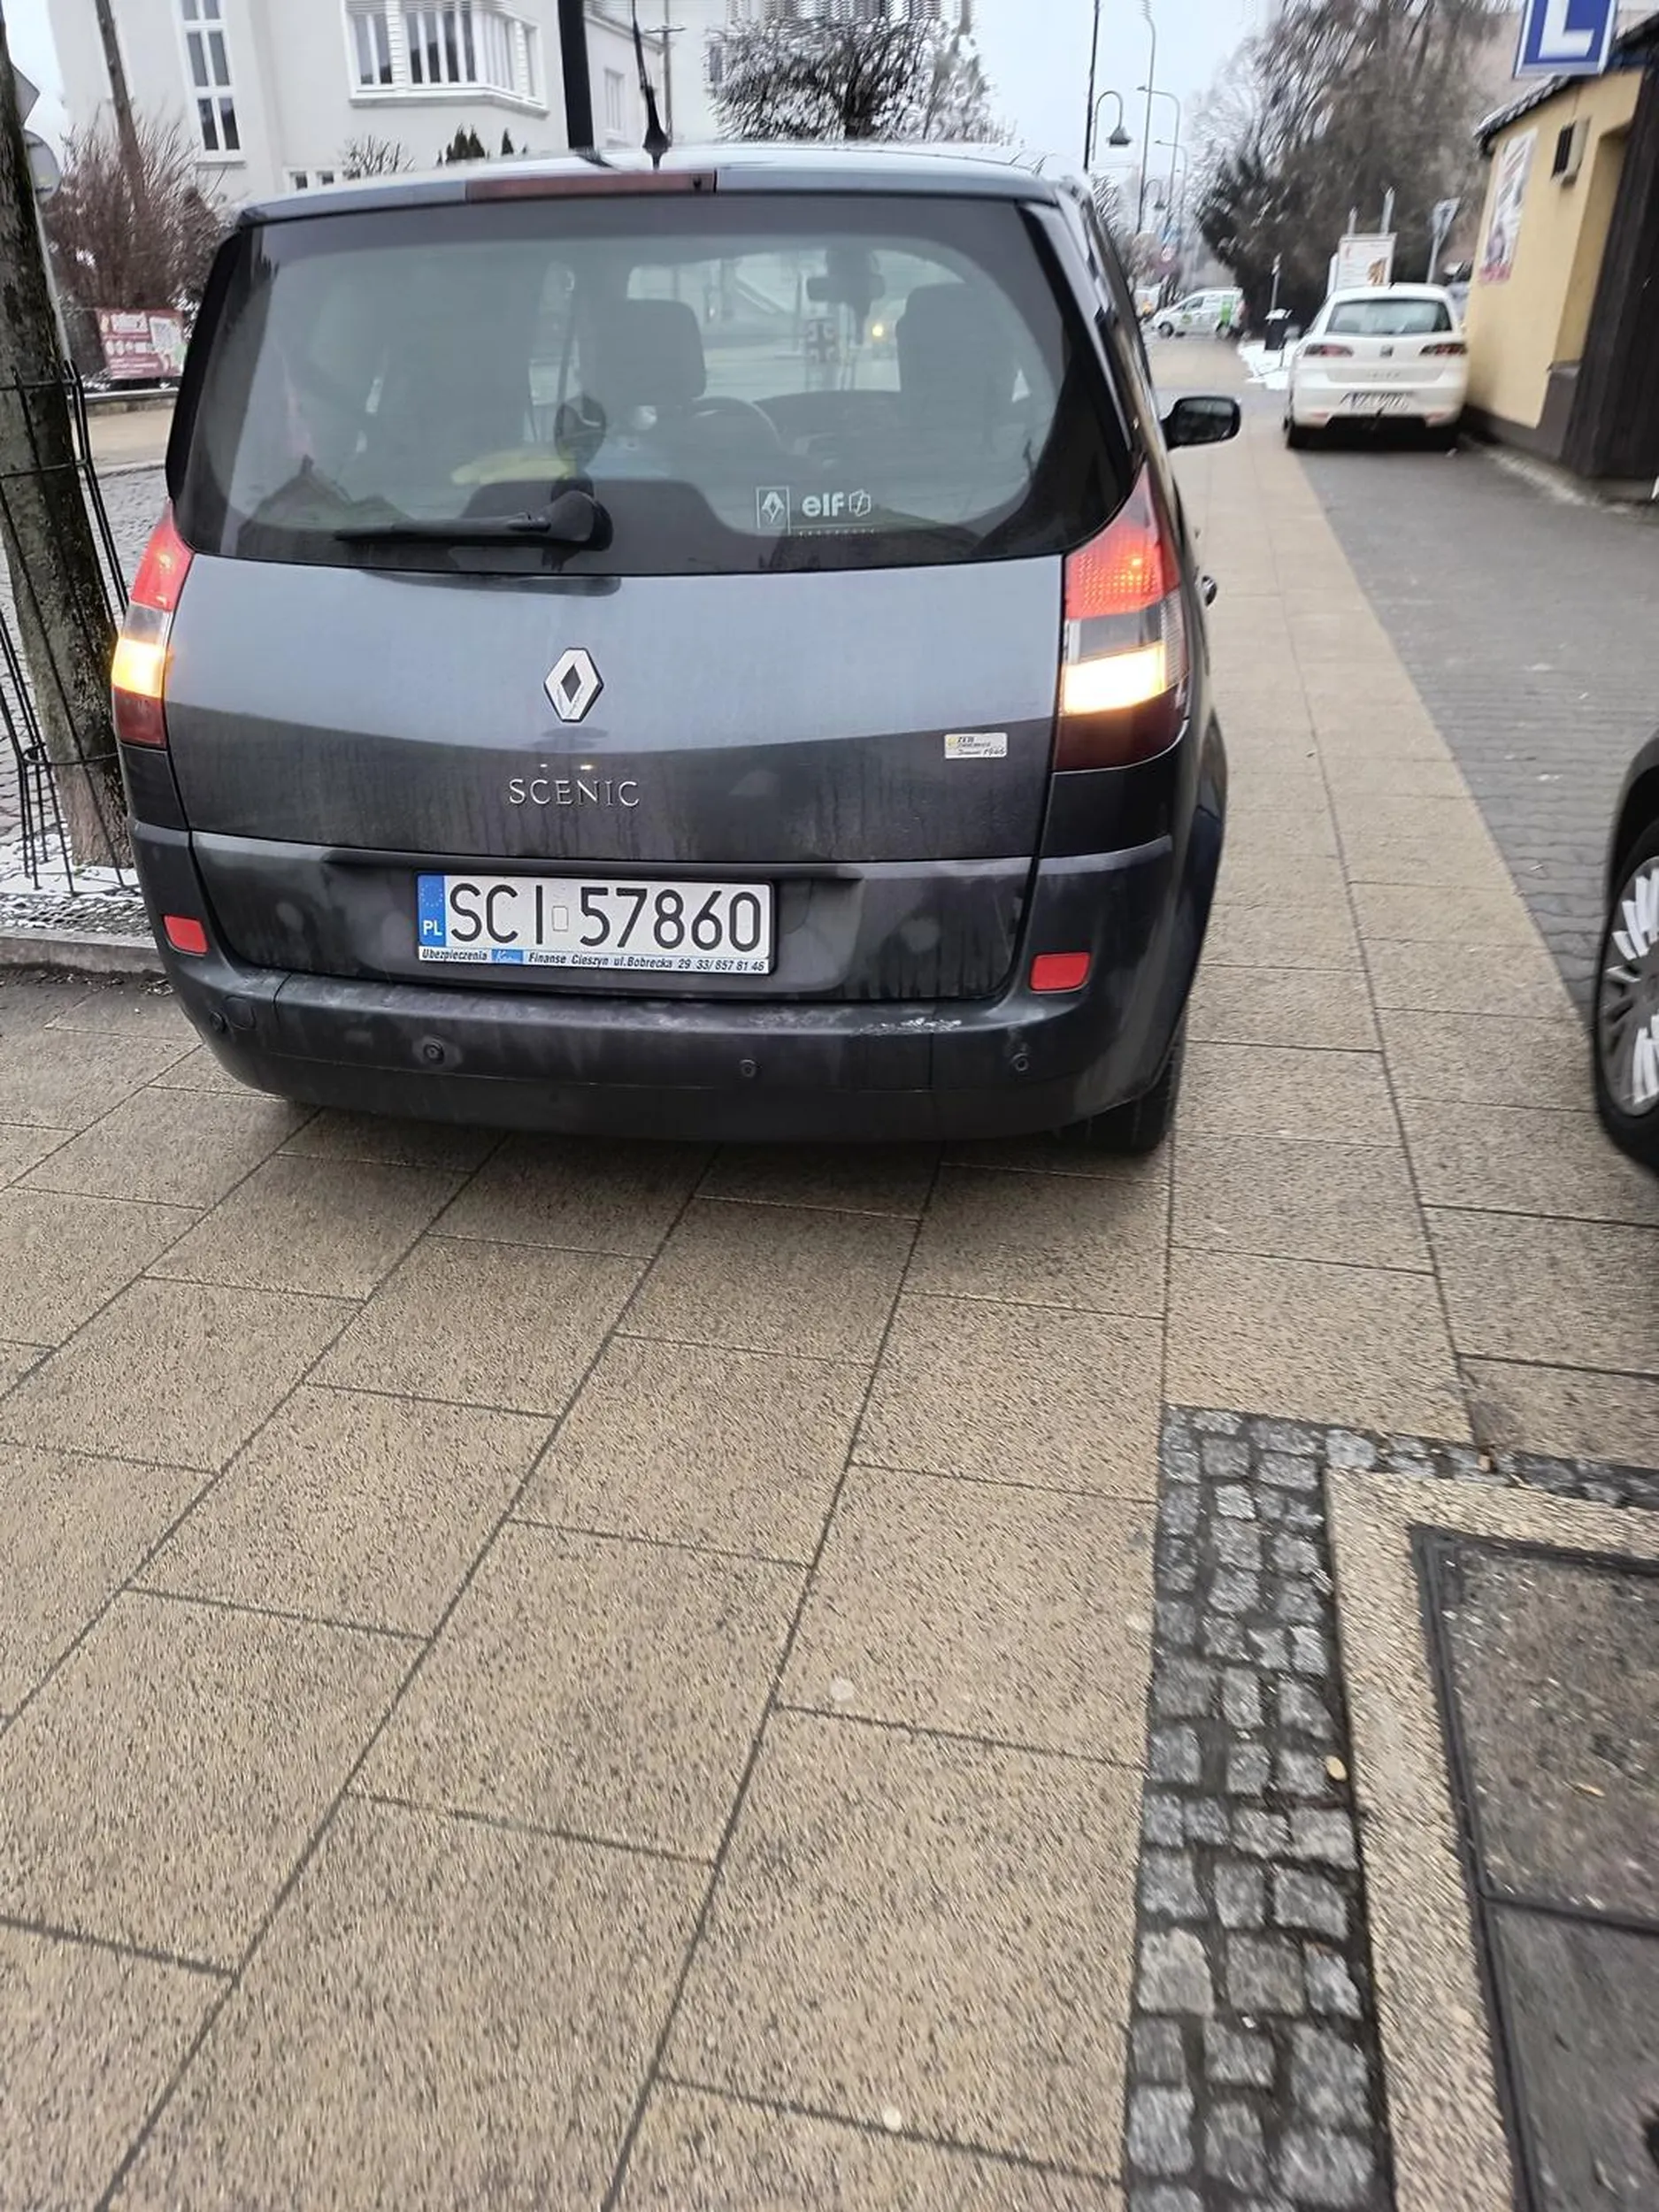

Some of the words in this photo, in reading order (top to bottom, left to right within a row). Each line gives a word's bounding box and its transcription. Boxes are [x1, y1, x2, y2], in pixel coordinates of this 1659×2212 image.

[1538, 0, 1594, 59] L
[802, 491, 844, 517] elf
[509, 779, 640, 807] SCENIC
[423, 920, 442, 936] PL
[449, 882, 543, 945] SCI
[580, 887, 761, 952] 57860
[422, 949, 488, 962] Ubezpieczenia
[528, 952, 566, 964] Finanse
[572, 954, 609, 968] Cieszyn
